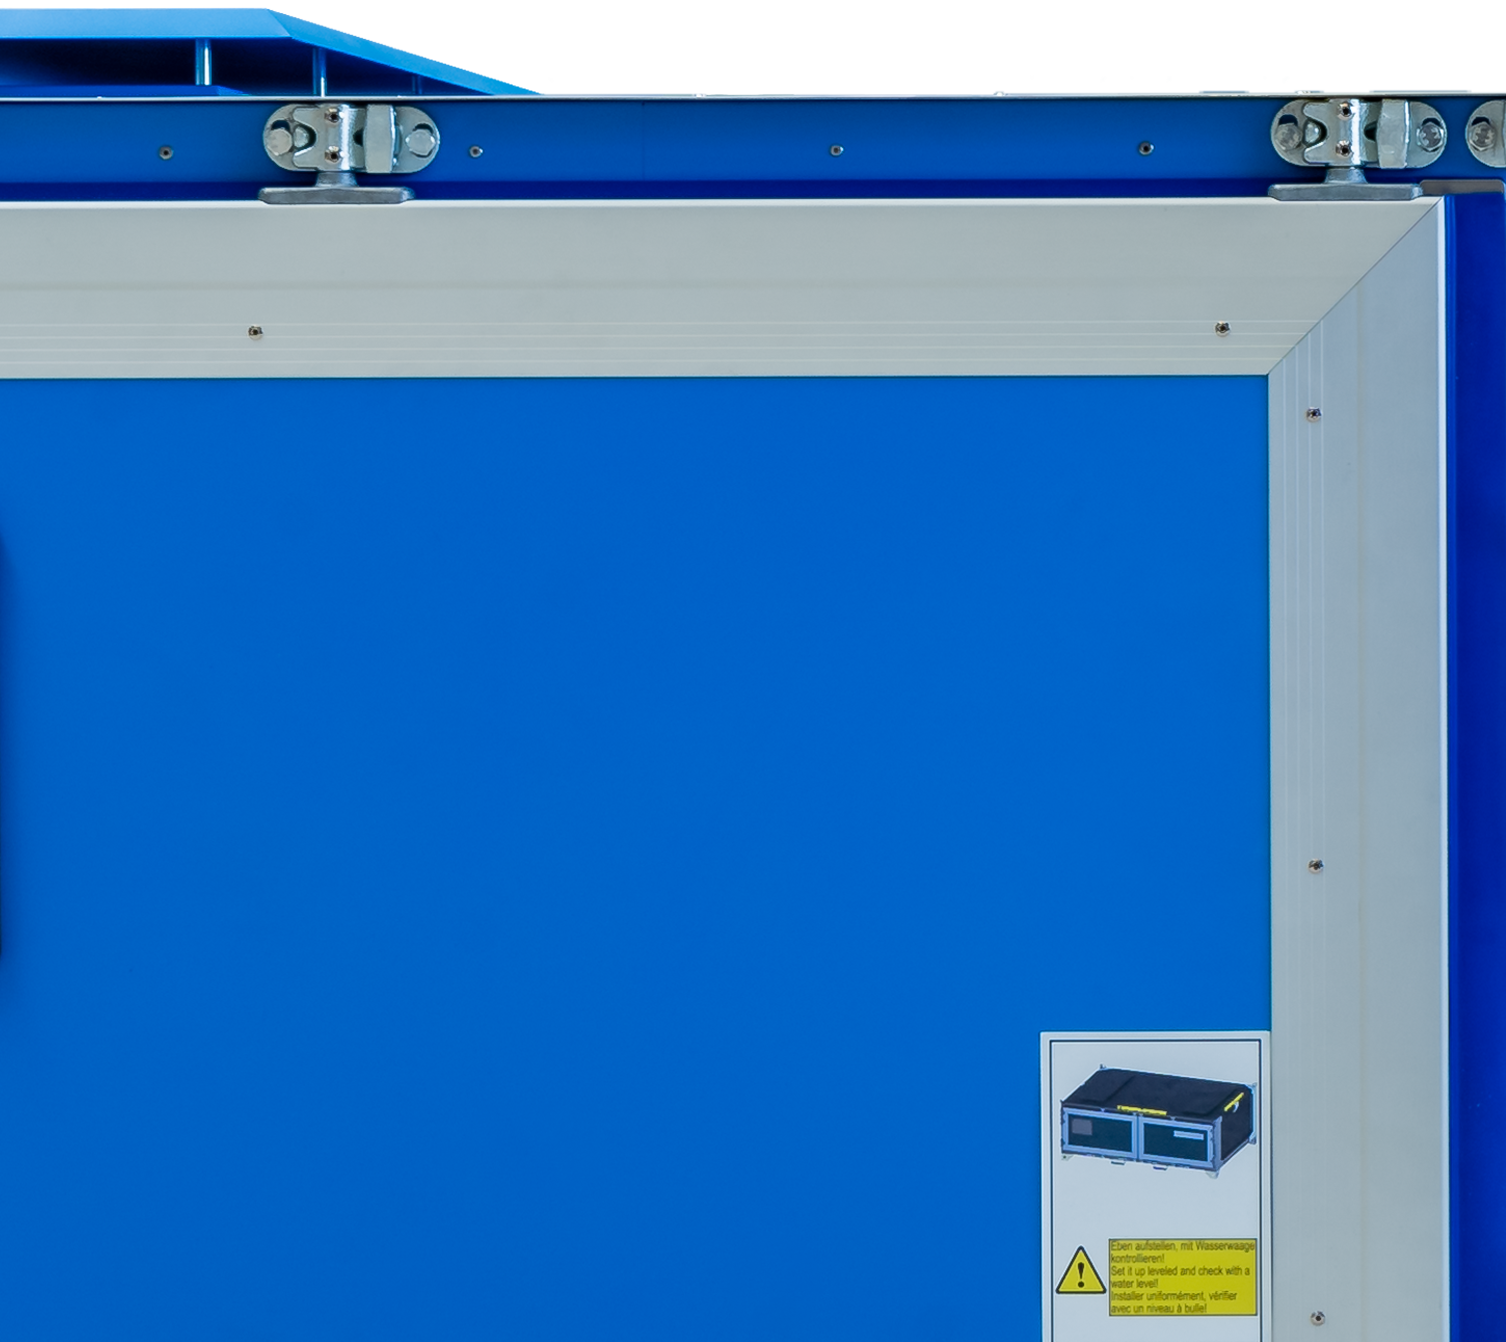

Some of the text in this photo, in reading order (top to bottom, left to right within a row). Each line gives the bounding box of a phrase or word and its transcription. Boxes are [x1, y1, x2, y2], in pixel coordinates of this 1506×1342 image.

[1112, 1241, 1255, 1253] Eben aufstellen, mit Wasserwaage
[1111, 1254, 1164, 1263] kontrollieren!
[1112, 1266, 1250, 1278] Set it up leveled and check with a
[1111, 1279, 1158, 1288] water level!
[1112, 1291, 1144, 1301] Installer
[1208, 1291, 1237, 1301] vérifier
[1111, 1304, 1207, 1313] avec un niveau à bulle!
